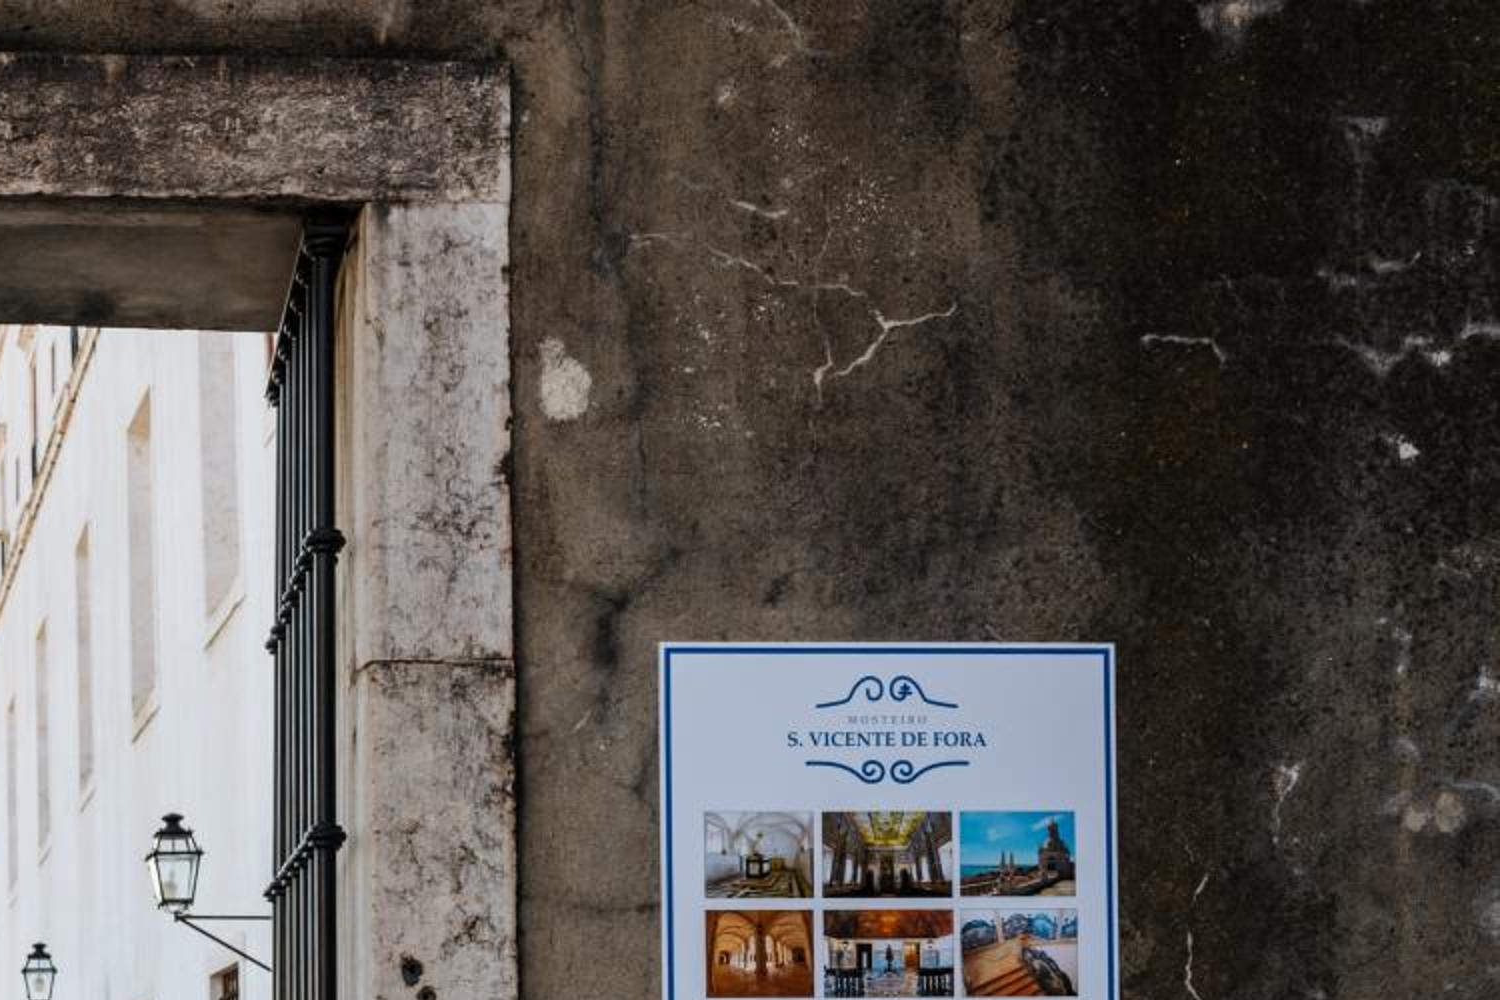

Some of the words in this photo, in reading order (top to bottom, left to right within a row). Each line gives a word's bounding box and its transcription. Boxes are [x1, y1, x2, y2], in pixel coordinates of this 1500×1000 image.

[847, 715, 928, 725] MOSTEIRO
[787, 731, 803, 747] S.
[809, 731, 895, 747] VICENTE
[901, 731, 929, 747] DE
[933, 731, 987, 747] FORA
